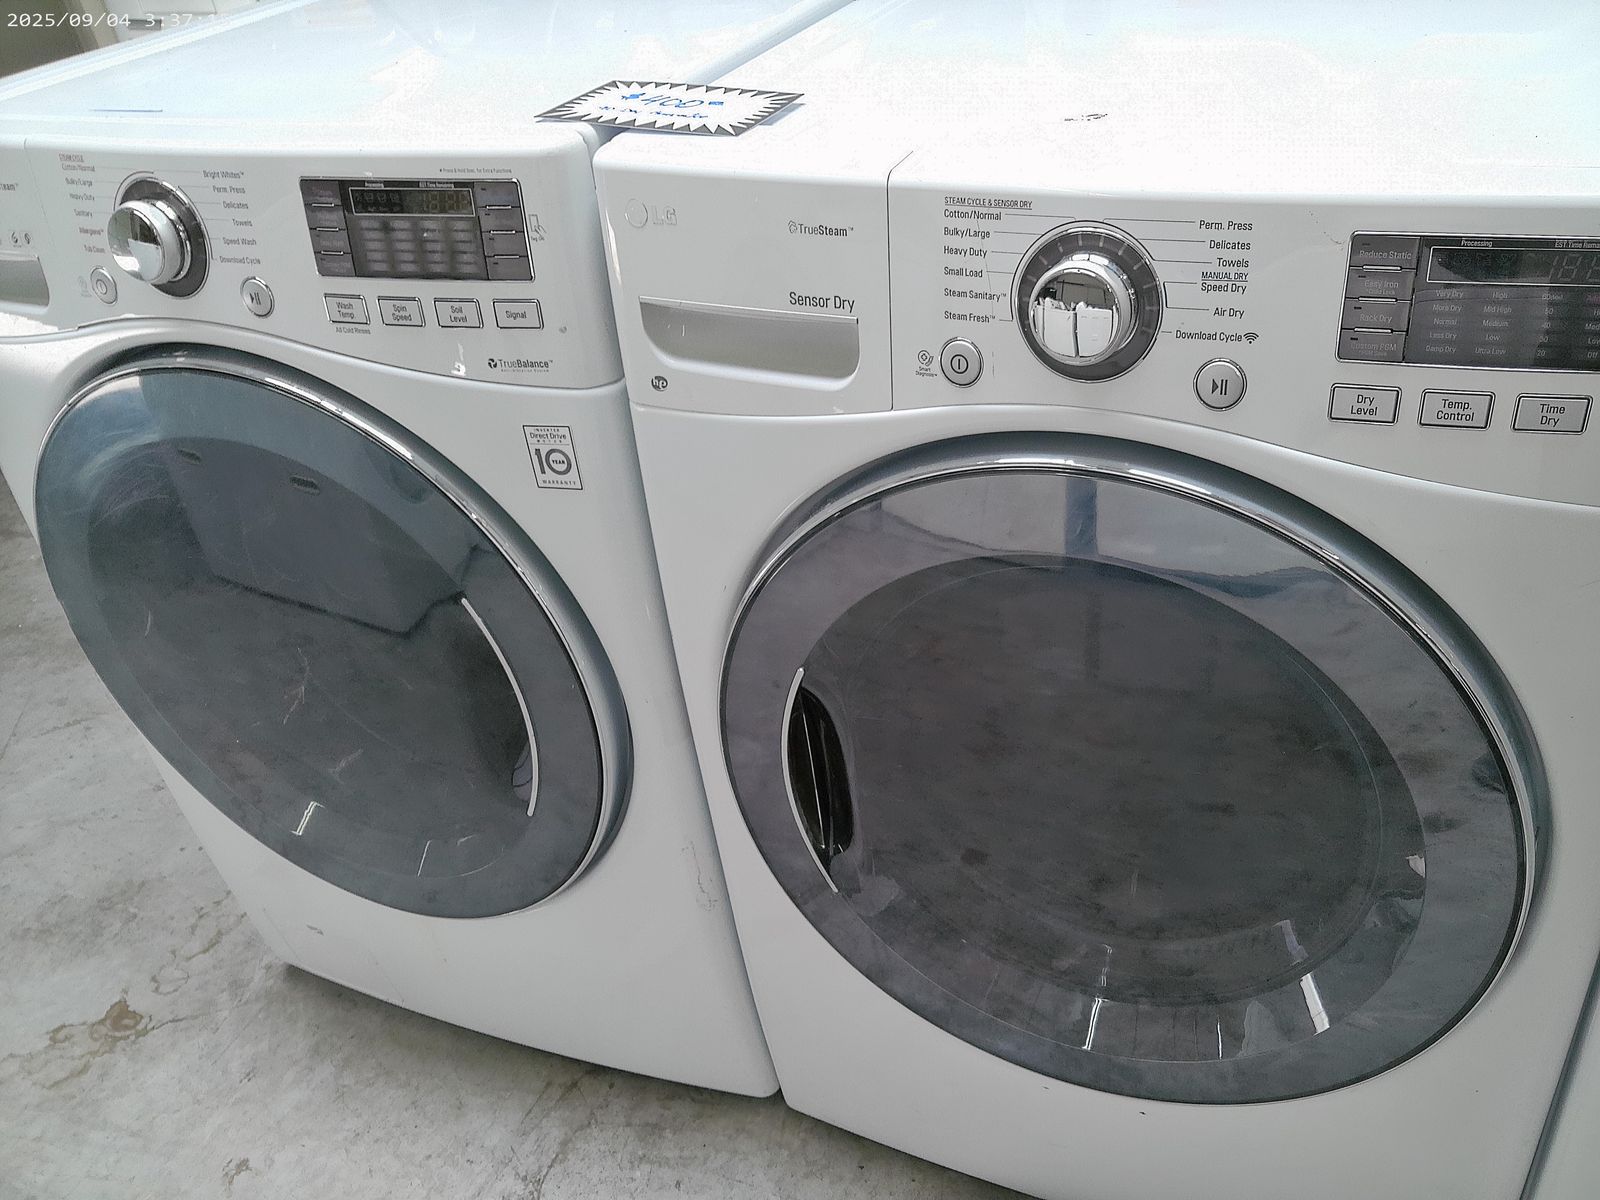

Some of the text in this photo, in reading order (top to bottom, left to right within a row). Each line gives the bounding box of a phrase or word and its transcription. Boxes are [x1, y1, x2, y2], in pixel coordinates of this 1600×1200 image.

[230, 186, 246, 194] Press
[222, 201, 249, 209] Delicates
[945, 196, 1033, 209] STEAM CYCLE & SENSOR DRY
[652, 206, 677, 226] LG
[944, 209, 1002, 221] Cotton/Normal
[232, 218, 253, 227] Towels
[1199, 220, 1253, 231] Perm. Press
[944, 227, 991, 239] Bulky/Large
[222, 237, 257, 246] Speed Wash
[1209, 240, 1251, 250] Delicates
[1461, 239, 1493, 248] Processing
[944, 246, 988, 258] Heavy Duty
[1359, 250, 1412, 260] Reduce Static
[219, 256, 245, 264] Download
[1217, 258, 1249, 268] Towels
[944, 266, 983, 278] Small Load
[1201, 271, 1249, 281] MANUAL DRY
[944, 288, 967, 298] Steam
[1201, 282, 1247, 295] Speed Dry
[1436, 289, 1464, 299] Very Dry
[1492, 291, 1508, 299] High
[336, 301, 354, 310] Wash
[789, 291, 855, 313] Sensor Dry
[392, 304, 408, 313] Spin
[451, 305, 463, 314] Soil
[1213, 307, 1245, 319] Air Dry
[1433, 304, 1463, 313] More Dry
[1496, 306, 1512, 314] High
[338, 310, 357, 320] Temp.
[392, 313, 412, 322] Speed
[450, 314, 467, 323] Level
[505, 310, 527, 320] Signal
[944, 311, 967, 321] Steam
[1359, 313, 1393, 323] Rack Dry
[1482, 319, 1508, 327] Medium
[1175, 329, 1243, 343] Download Cycle
[1445, 332, 1457, 340] Dry
[1425, 345, 1457, 353] Damp Dry
[1356, 394, 1375, 406] Dry
[1441, 399, 1472, 410] Temp.
[1350, 406, 1378, 416] Level
[1539, 404, 1566, 414] Time
[1436, 411, 1475, 422] Control
[1540, 415, 1560, 427] Dry
[535, 448, 572, 475] 10
